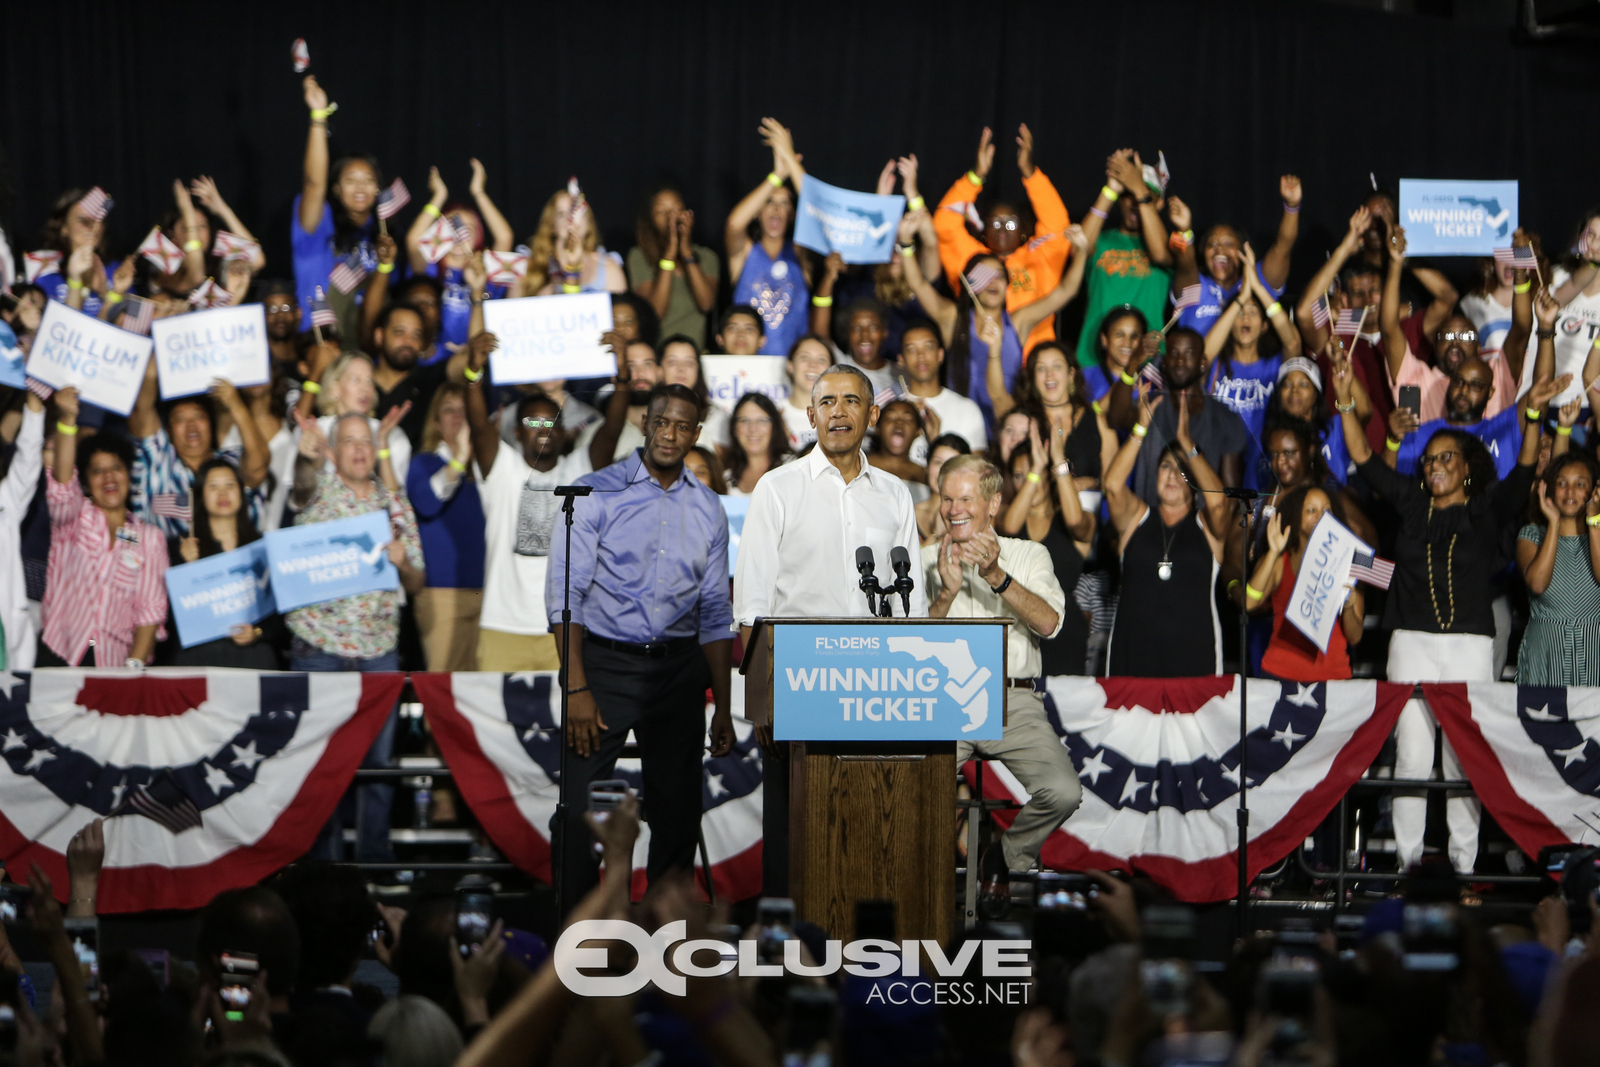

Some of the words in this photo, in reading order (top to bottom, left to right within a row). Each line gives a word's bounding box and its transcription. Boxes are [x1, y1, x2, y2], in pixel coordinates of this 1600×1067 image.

[1407, 208, 1484, 223] WINNING
[1434, 222, 1483, 238] TICKET
[165, 322, 257, 353] GILLUM
[500, 311, 599, 338] GILLUM
[42, 339, 99, 380] KING
[50, 321, 139, 372] GILLUM
[168, 345, 228, 374] KING
[502, 334, 566, 359] KING
[277, 547, 359, 575] WINNING
[308, 561, 360, 585] TICKET
[1300, 530, 1340, 618] GILLUM
[180, 575, 256, 611] WINNING
[1310, 571, 1335, 631] KING
[815, 637, 833, 649] FL
[839, 637, 881, 649] DEMS
[785, 667, 940, 692] WINNING
[838, 697, 938, 722] TICKET
